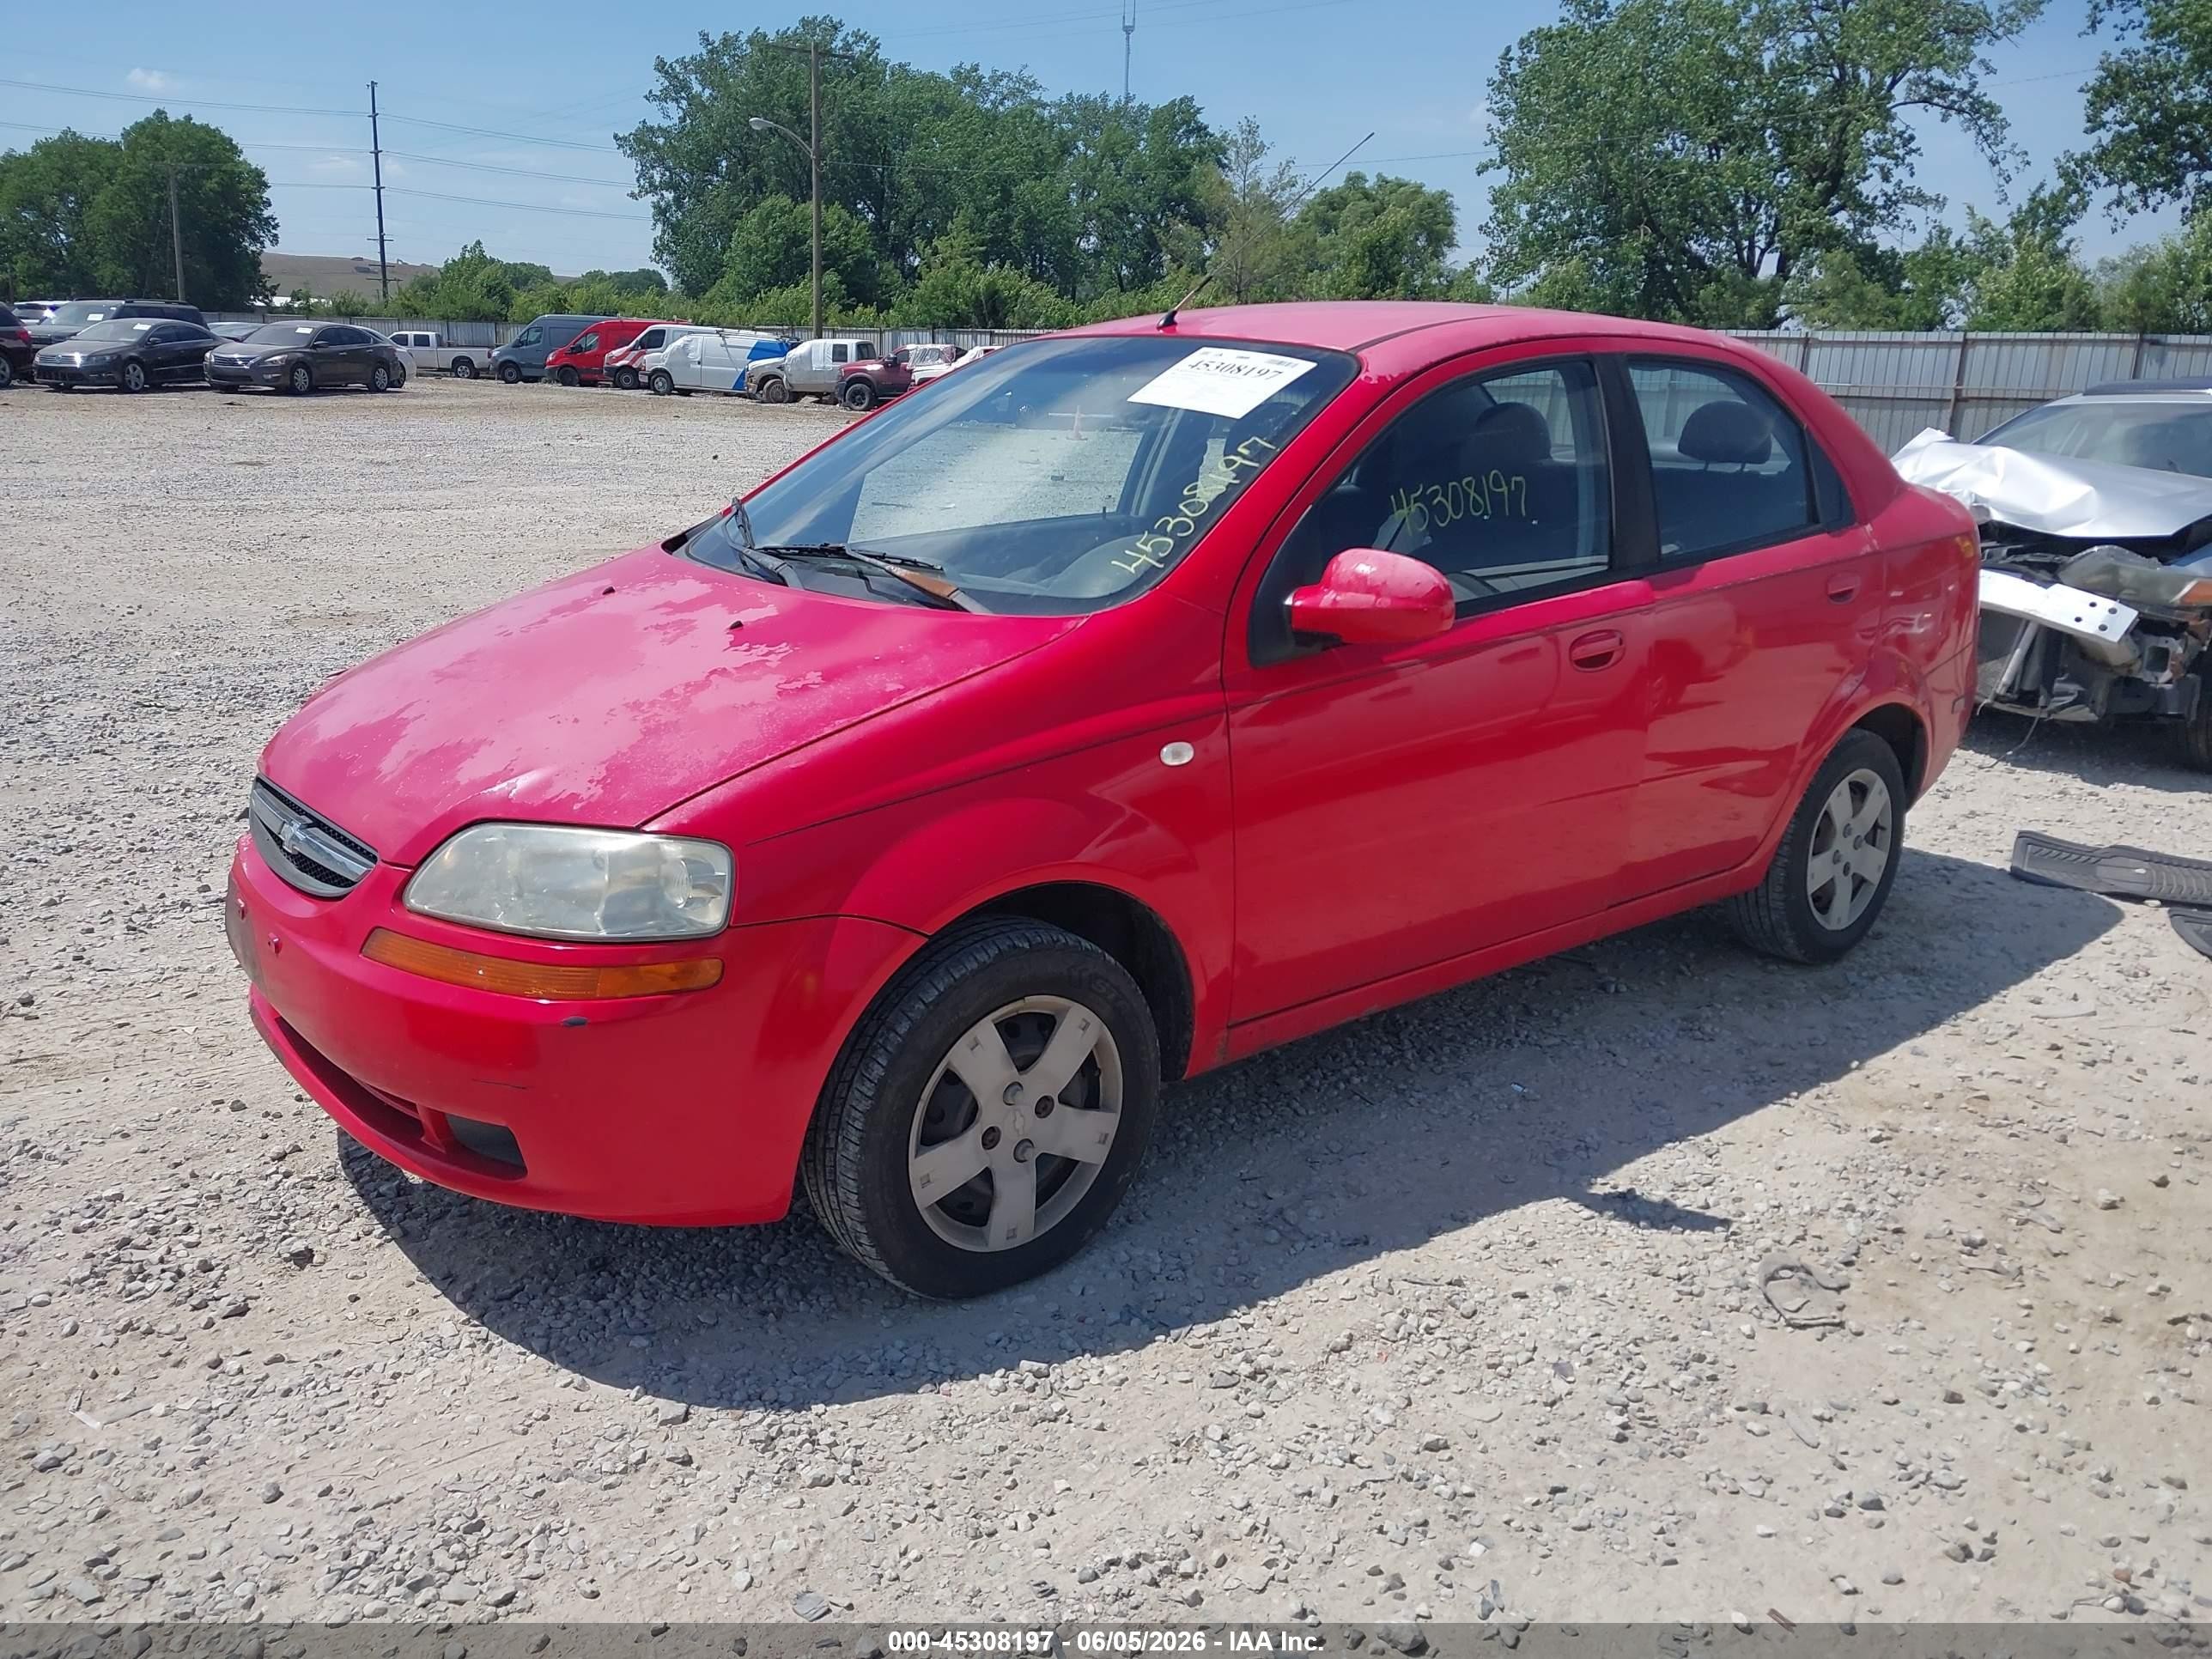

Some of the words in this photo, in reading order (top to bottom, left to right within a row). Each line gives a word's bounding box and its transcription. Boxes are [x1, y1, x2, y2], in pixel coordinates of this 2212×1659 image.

[1188, 359, 1284, 380] 45308197
[1111, 436, 1277, 574] 45308197
[1390, 470, 1526, 536] 45308197
